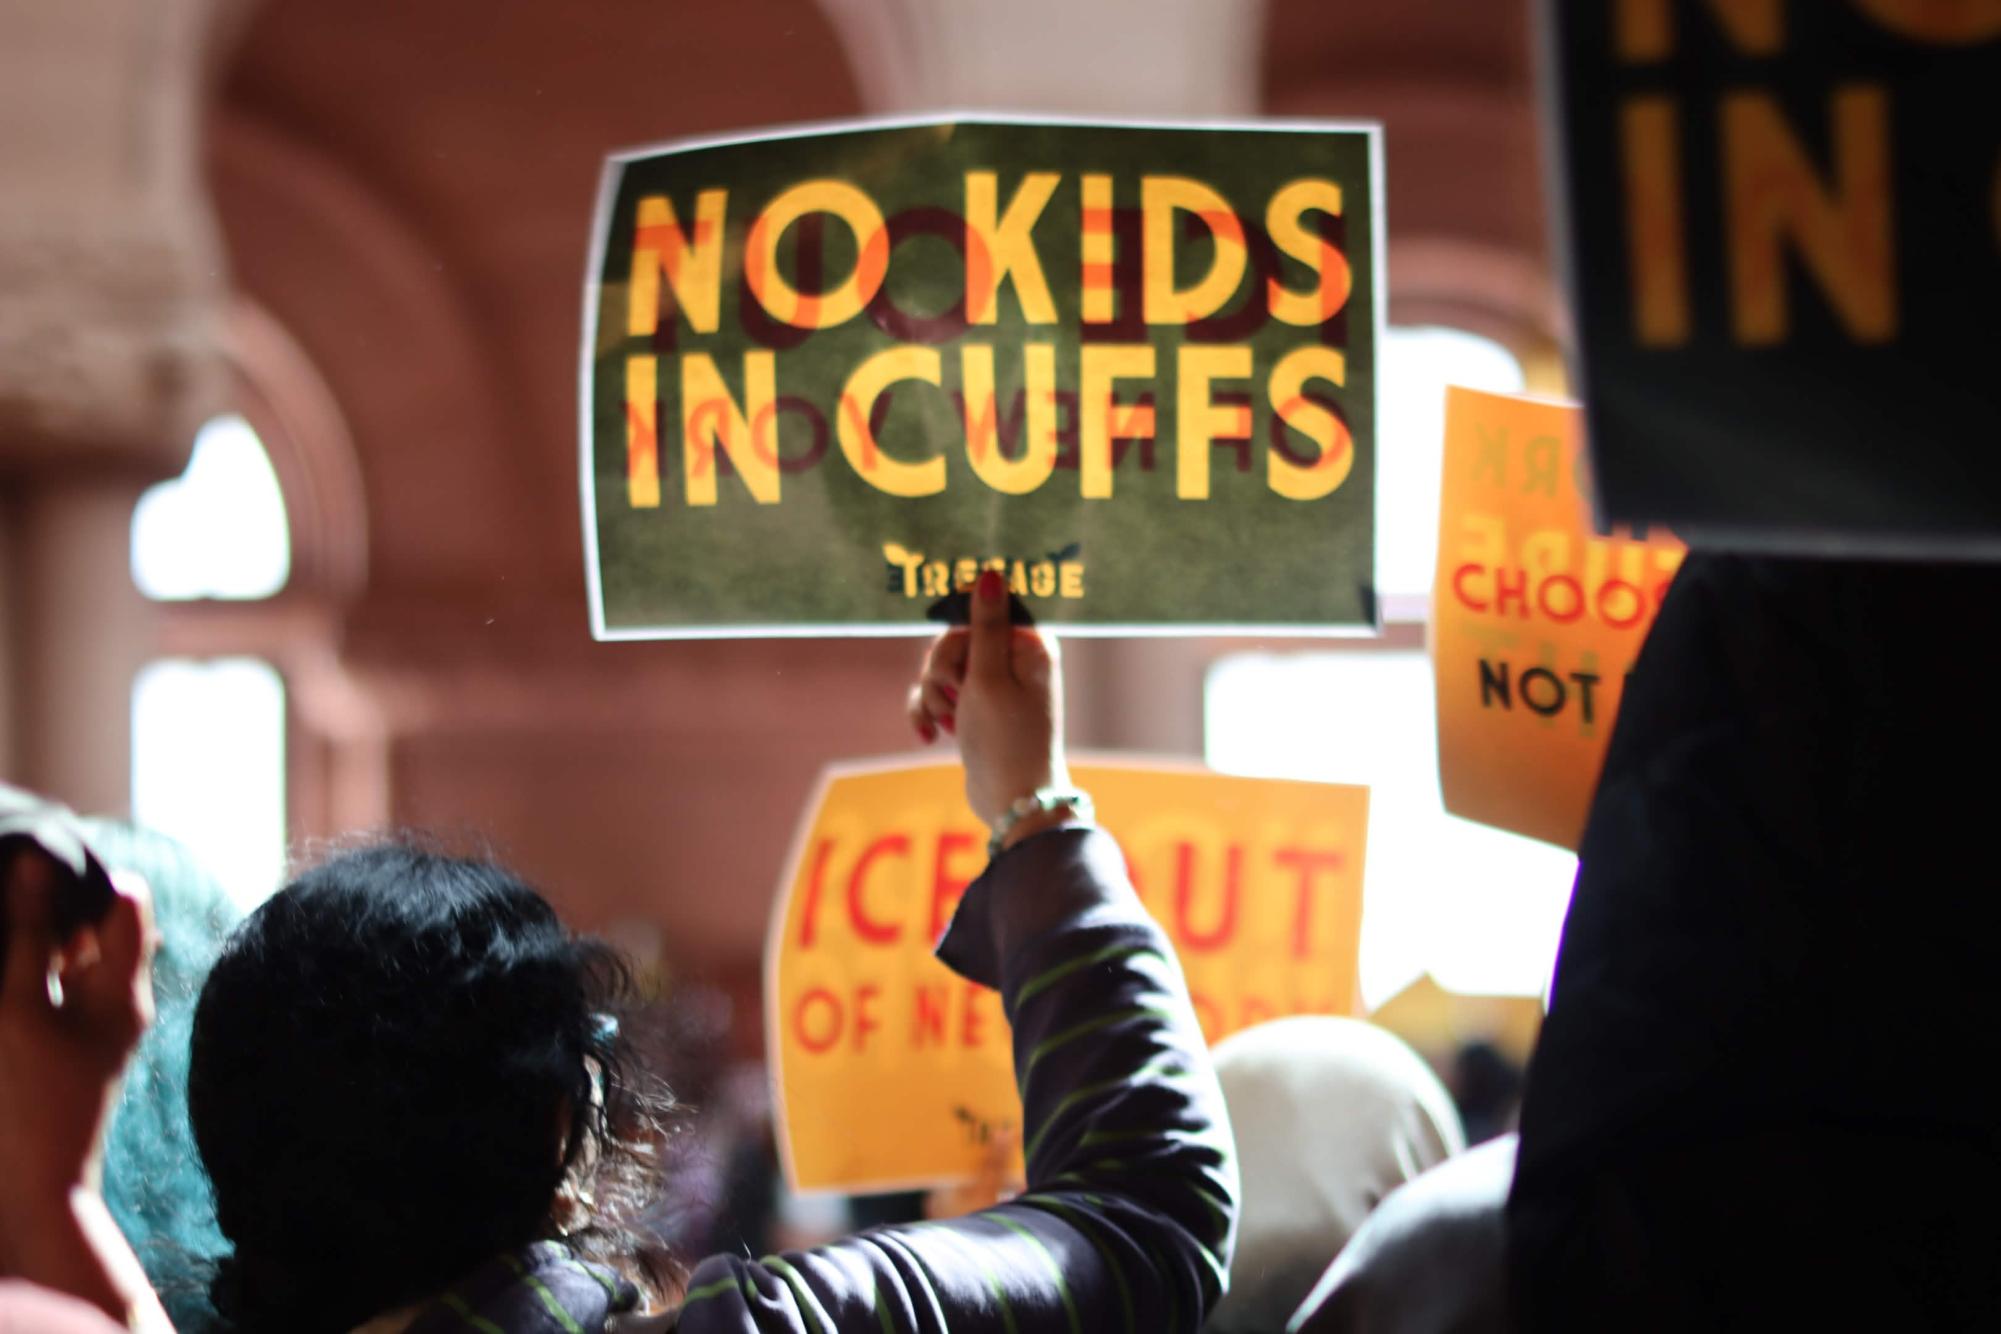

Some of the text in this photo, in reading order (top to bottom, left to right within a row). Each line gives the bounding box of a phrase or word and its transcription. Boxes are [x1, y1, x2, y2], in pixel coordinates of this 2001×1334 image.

[627, 169, 1352, 335] NO KIDS
[1621, 83, 1897, 348] IN
[626, 343, 1355, 508] IN CUFFS
[1452, 563, 1672, 631] CHOO
[1478, 658, 1602, 725] NOT
[1127, 840, 1346, 960] UT
[792, 981, 986, 1055] OF NE
